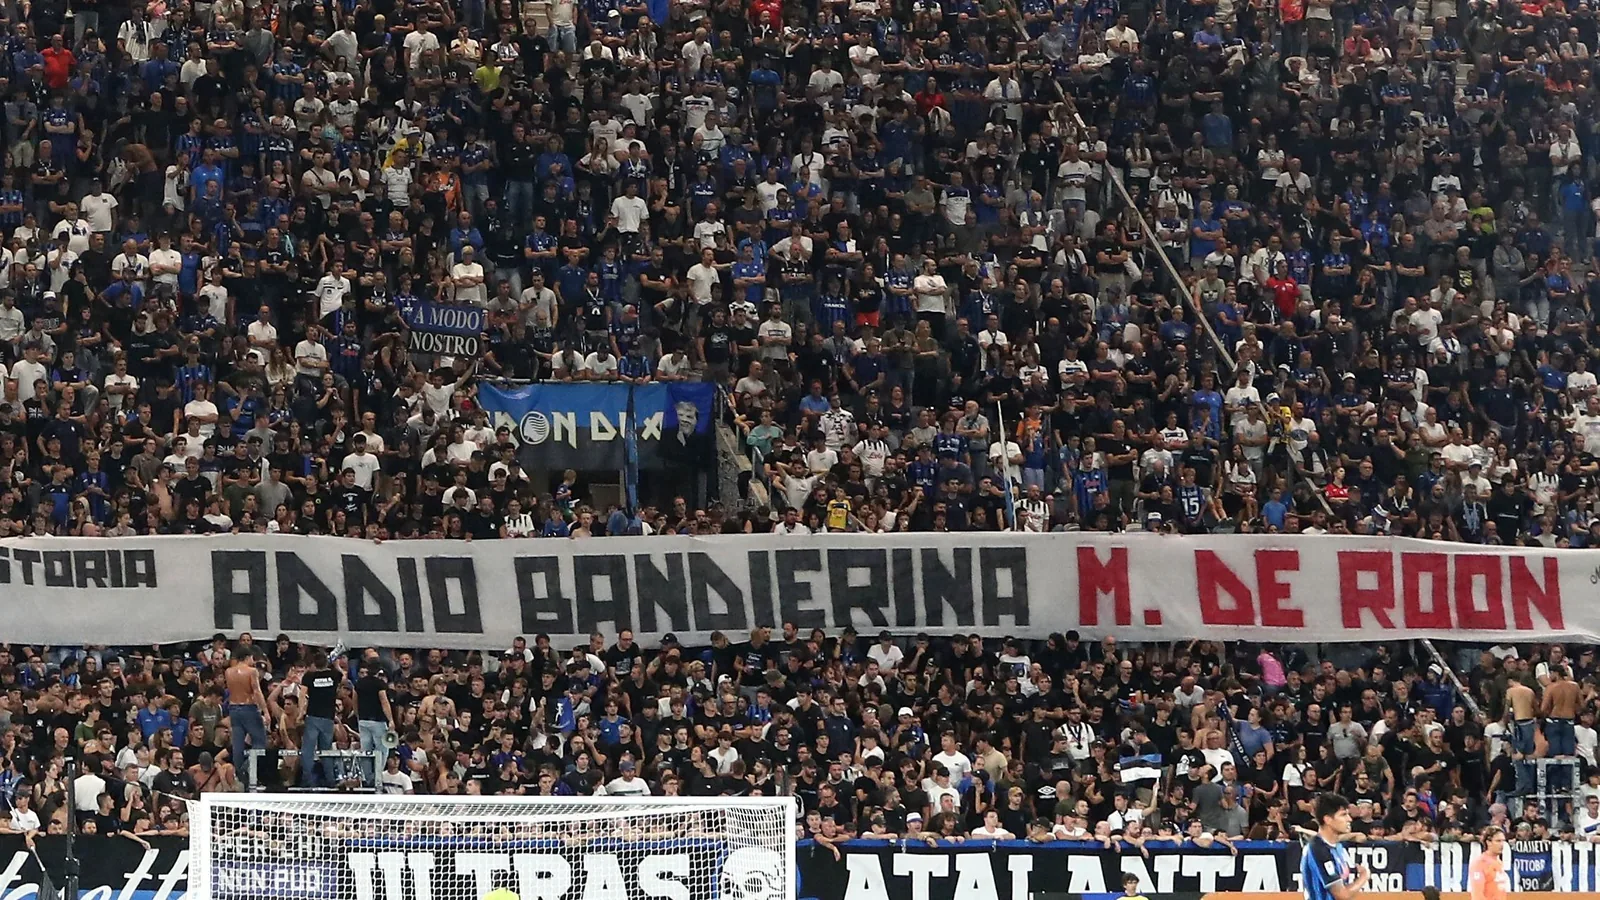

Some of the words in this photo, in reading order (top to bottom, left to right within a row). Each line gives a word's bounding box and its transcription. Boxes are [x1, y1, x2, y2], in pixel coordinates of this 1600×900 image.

[413, 306, 424, 324] A
[429, 307, 480, 330] MODO
[409, 331, 478, 356] NOSTRO
[1181, 497, 1199, 515] 15
[211, 550, 484, 634] ADDIO
[514, 547, 1030, 634] BANDIERINA
[1077, 547, 1162, 625] M.
[1195, 550, 1304, 627] DE
[1337, 551, 1564, 630] ROON
